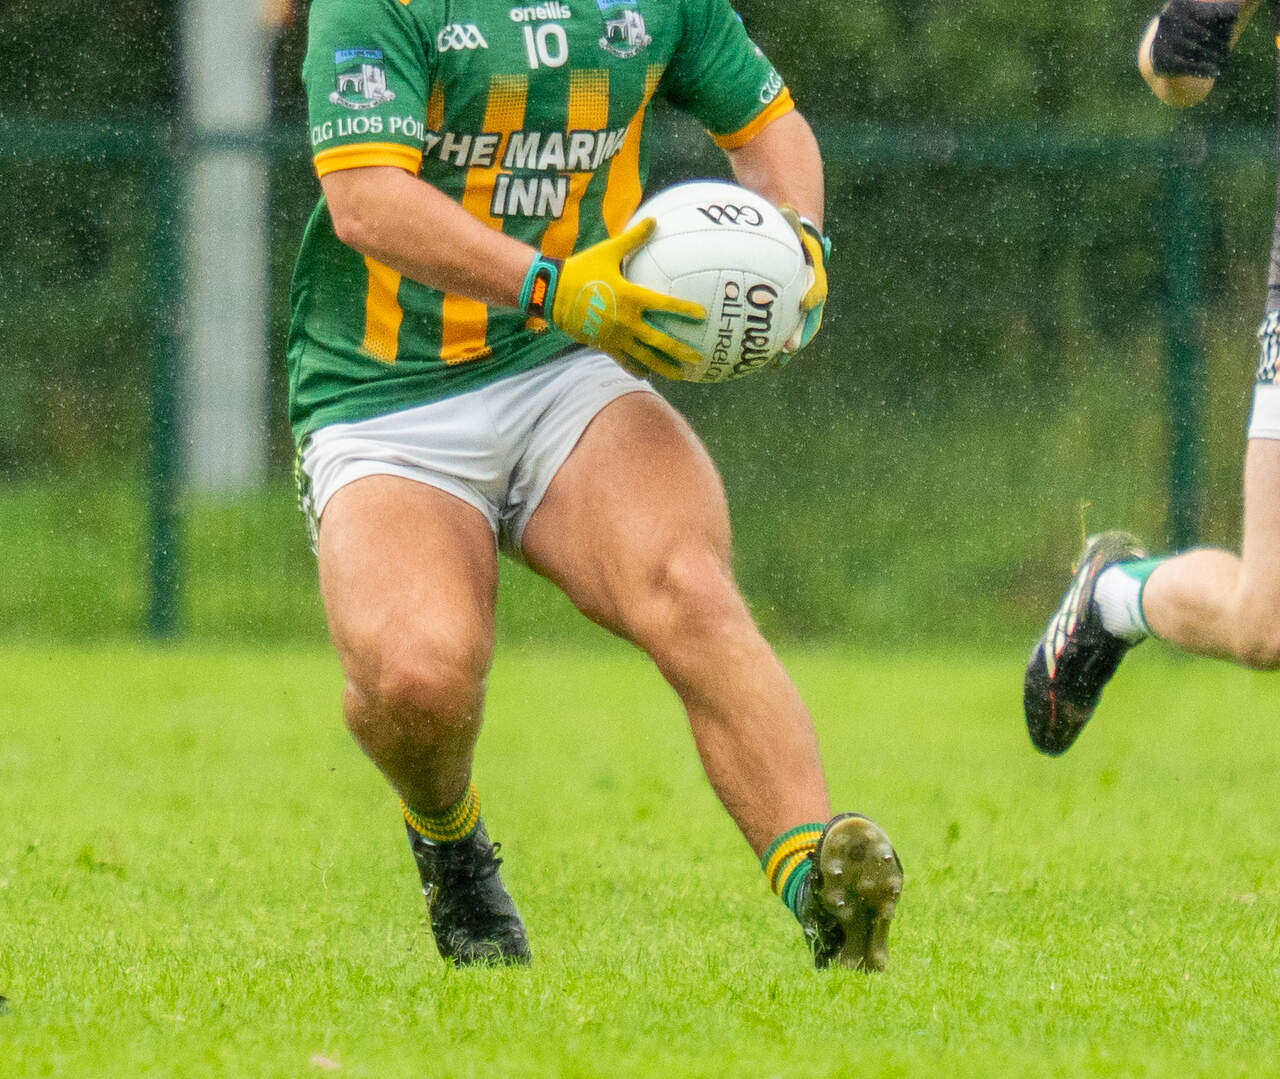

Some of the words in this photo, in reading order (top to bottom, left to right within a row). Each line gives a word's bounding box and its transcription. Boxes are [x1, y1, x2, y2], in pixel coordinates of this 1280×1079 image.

[437, 25, 489, 53] GAA
[524, 23, 569, 70] 10
[338, 116, 384, 137] LIOS
[492, 176, 568, 218] INN
